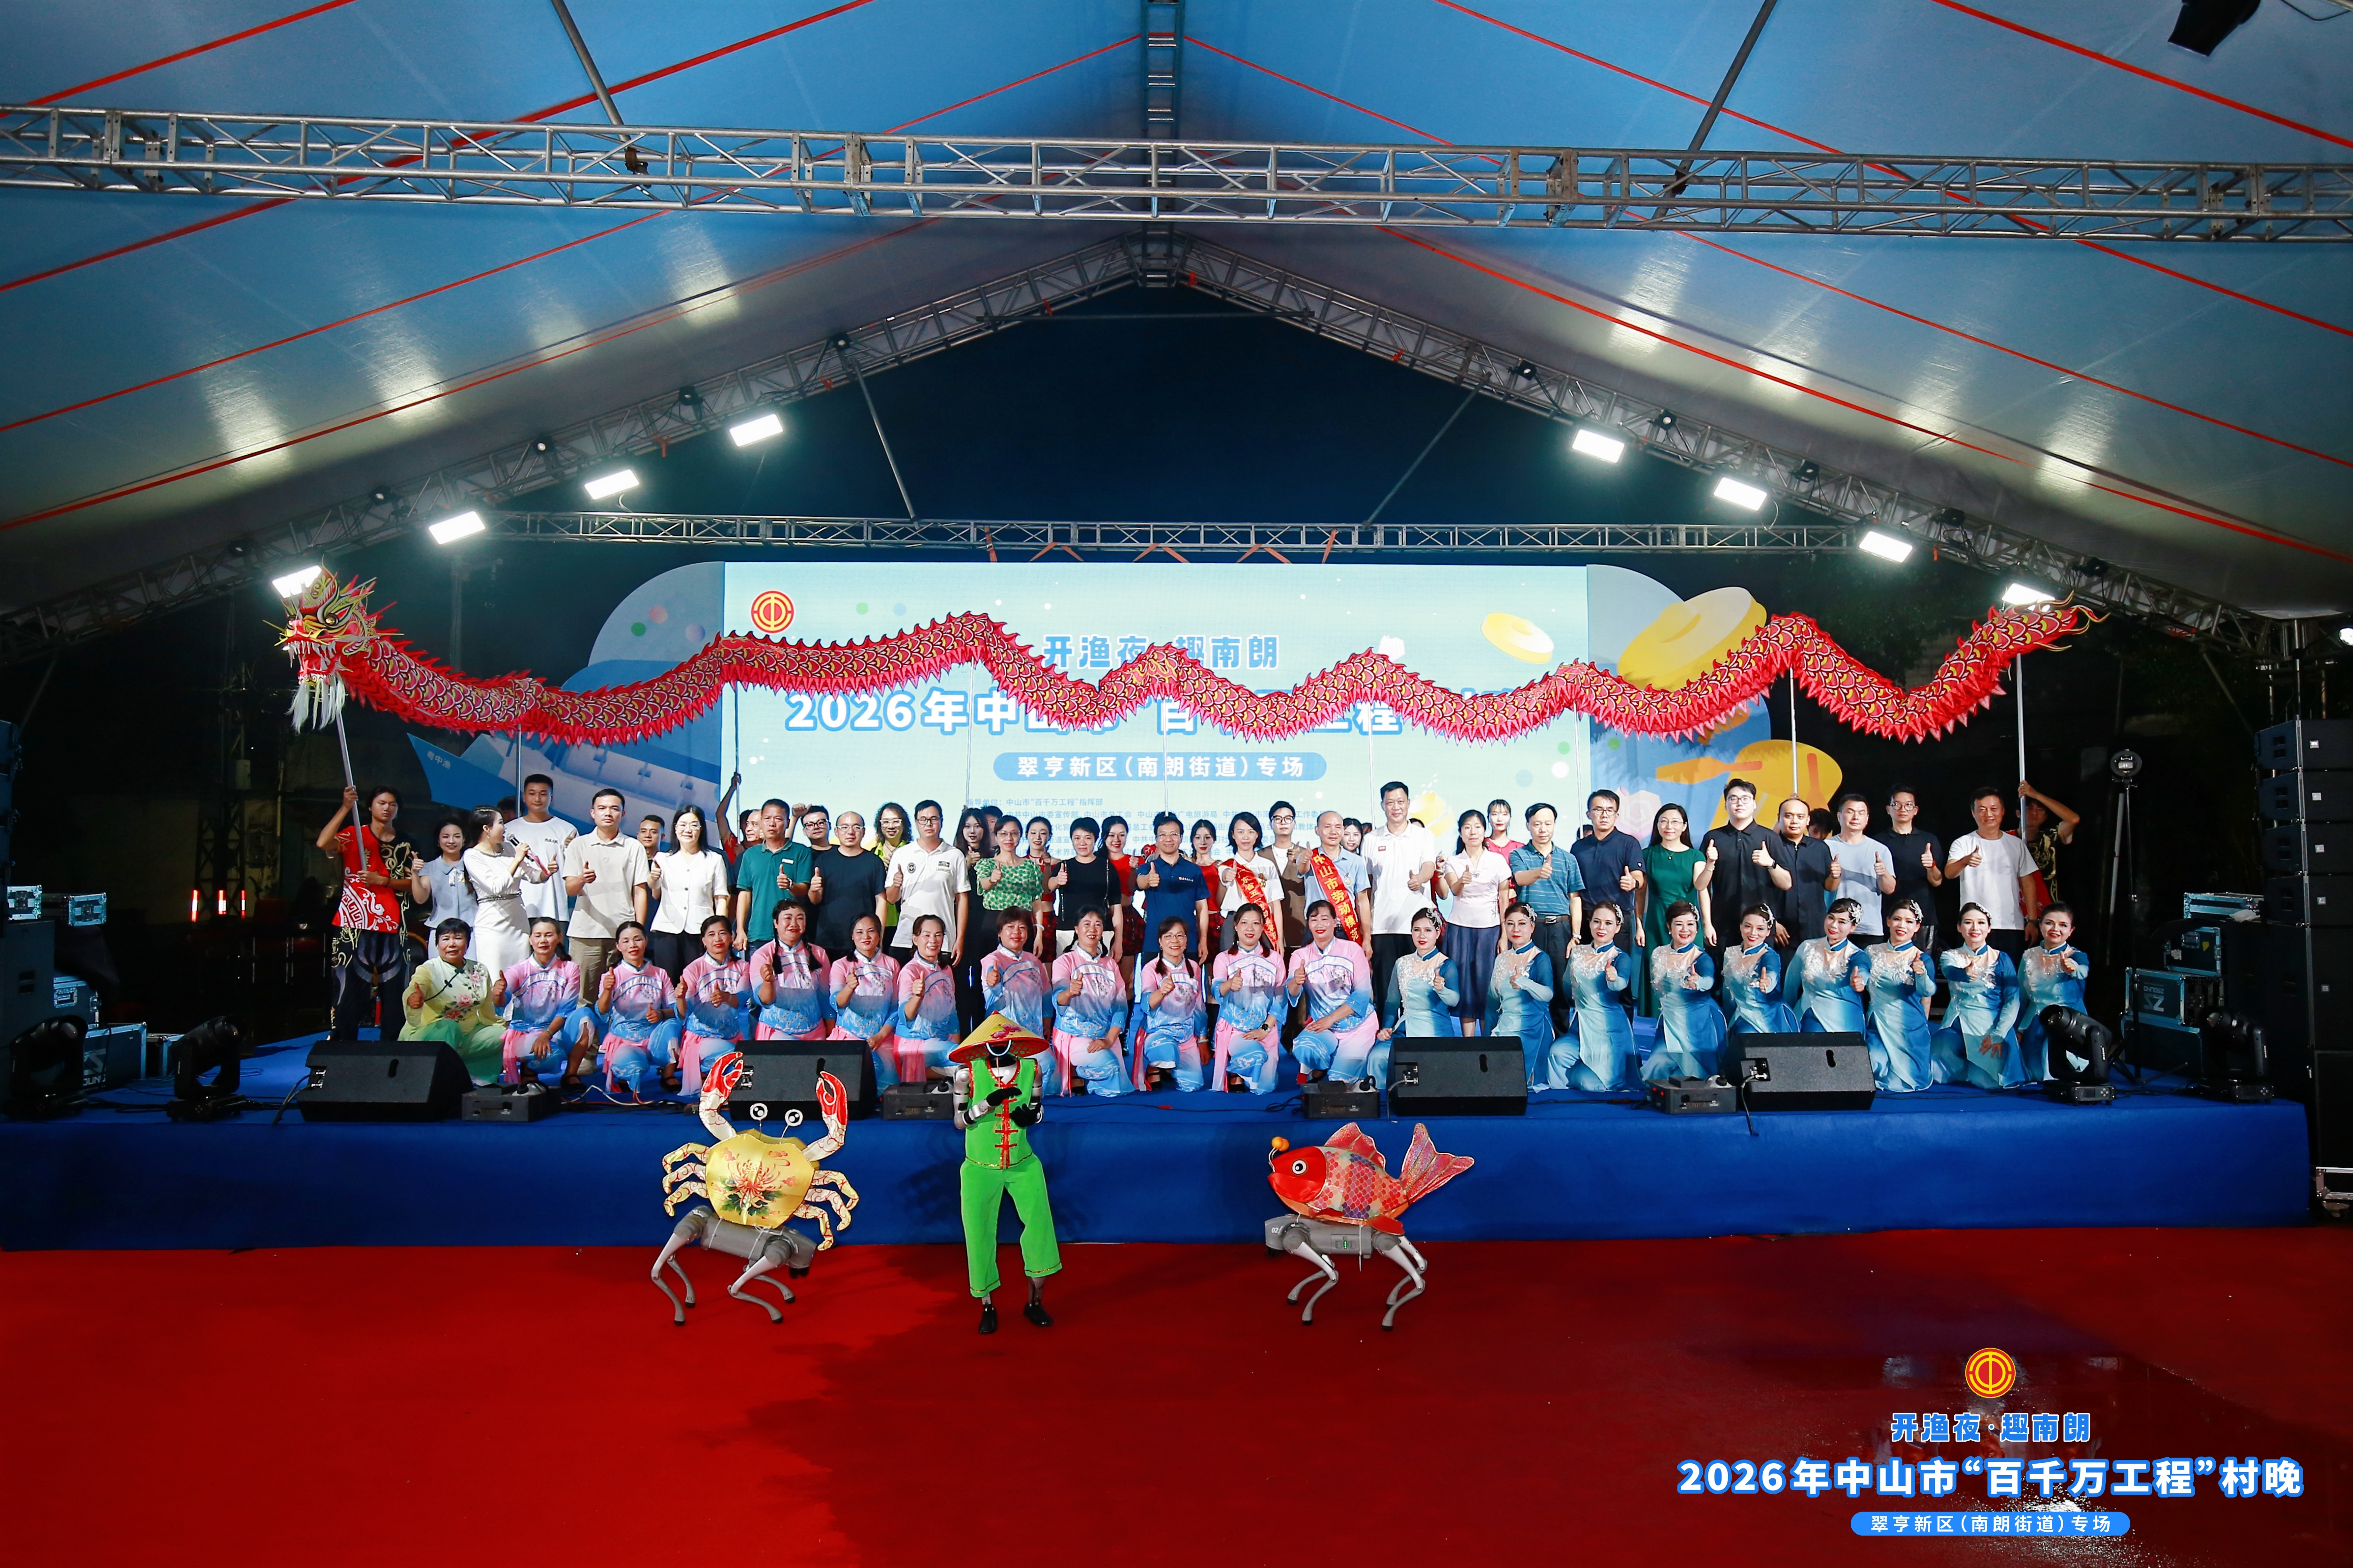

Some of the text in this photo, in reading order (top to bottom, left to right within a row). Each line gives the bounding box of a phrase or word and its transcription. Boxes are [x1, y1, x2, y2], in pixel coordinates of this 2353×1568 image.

[1043, 635, 1279, 669] 开渔夜趣南朗
[1017, 756, 1303, 778] 翠亨新区（南朗街道）专场
[1313, 854, 1359, 941] 中山市劳动模范
